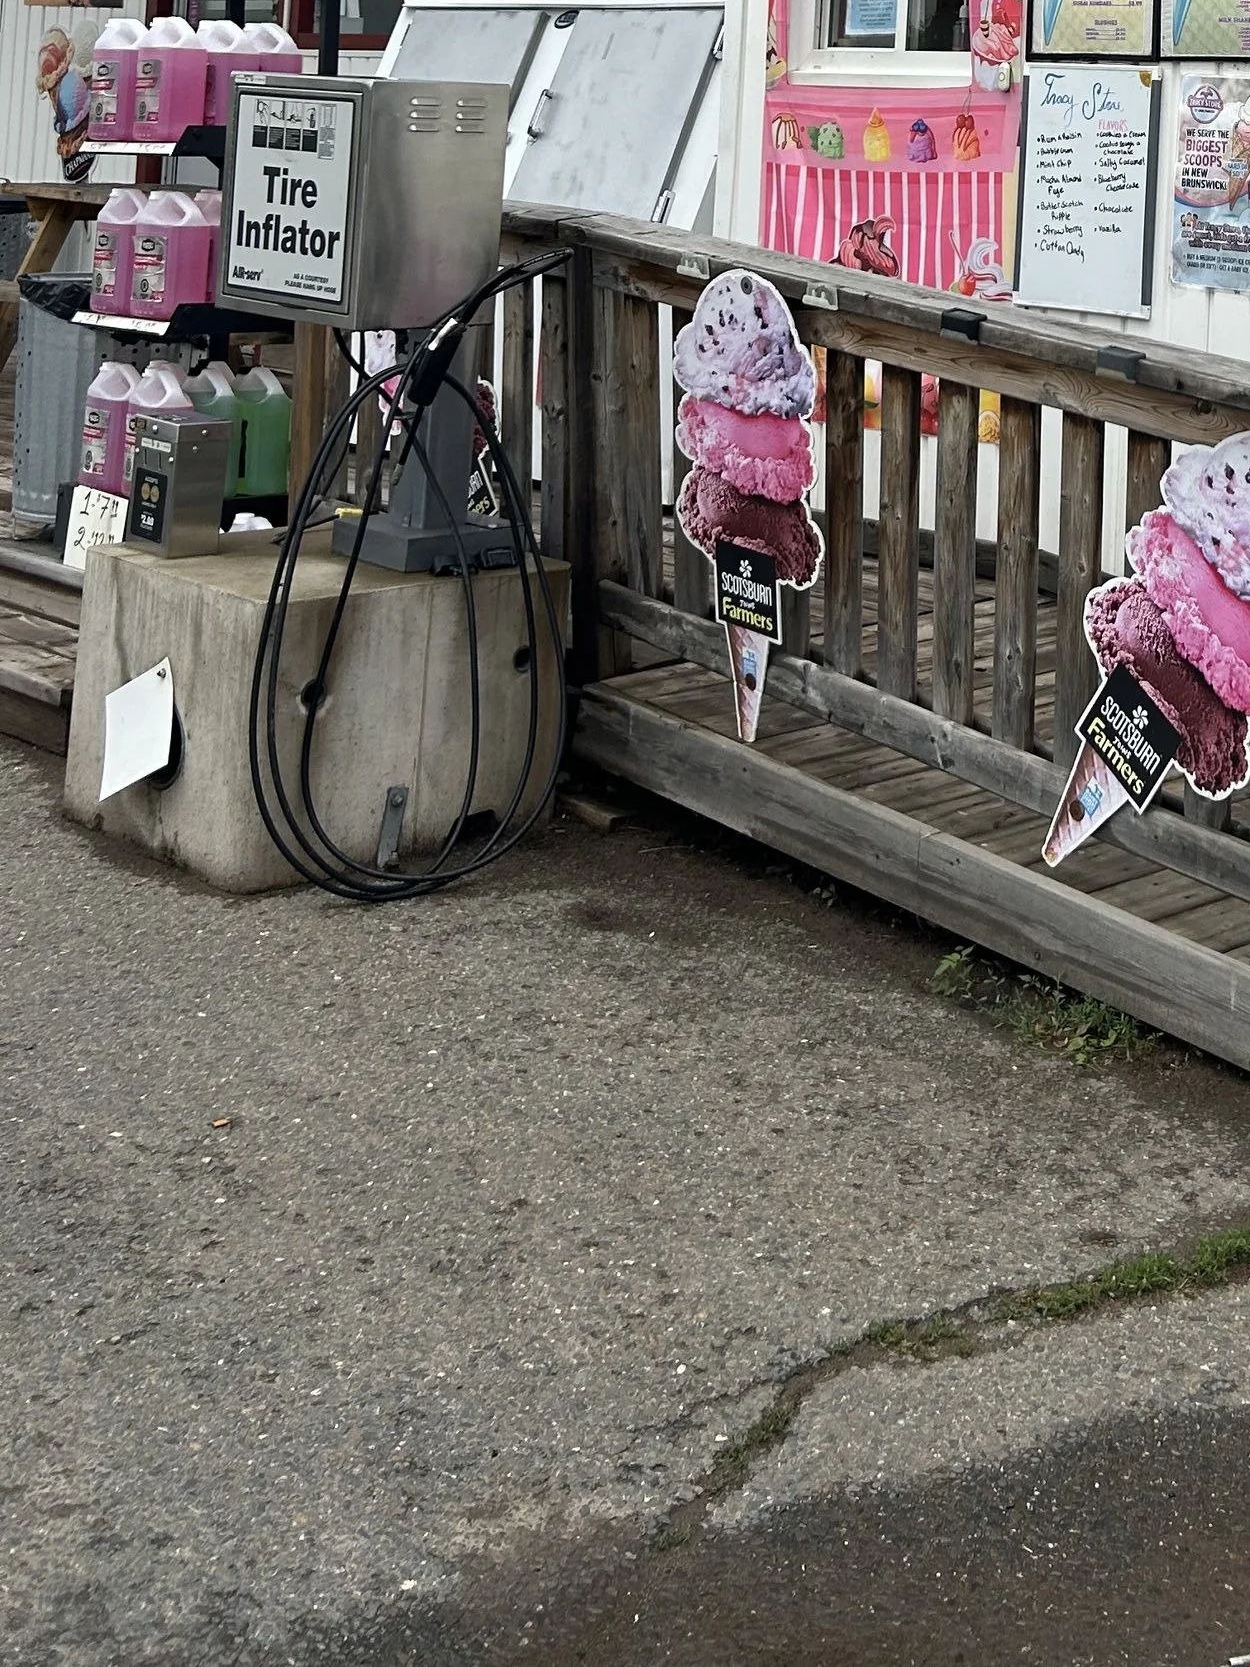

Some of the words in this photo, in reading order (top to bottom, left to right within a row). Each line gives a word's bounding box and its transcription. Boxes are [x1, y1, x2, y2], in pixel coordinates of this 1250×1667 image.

[1098, 118, 1129, 132] FLAVORS
[1186, 128, 1195, 137] WE
[1197, 129, 1216, 138] SERVE
[1217, 130, 1230, 139] THE
[1186, 138, 1228, 154] BIGGEST
[1098, 157, 1117, 170] Salty
[1183, 154, 1222, 168] SCOOPS
[1182, 167, 1190, 177] IN
[1191, 168, 1208, 178] NEW
[263, 166, 318, 209] Tire
[1181, 177, 1228, 191] BRUNSWICK!
[236, 210, 340, 259] Inflator
[1043, 224, 1083, 238] Strawberry
[1040, 239, 1066, 252] Cotton
[284, 280, 302, 288] PLEASE
[721, 571, 773, 607] SCOTSBURN
[722, 596, 773, 631] Farmers
[1100, 695, 1161, 775] SCOTSBURN
[1087, 716, 1145, 795] Farmers
